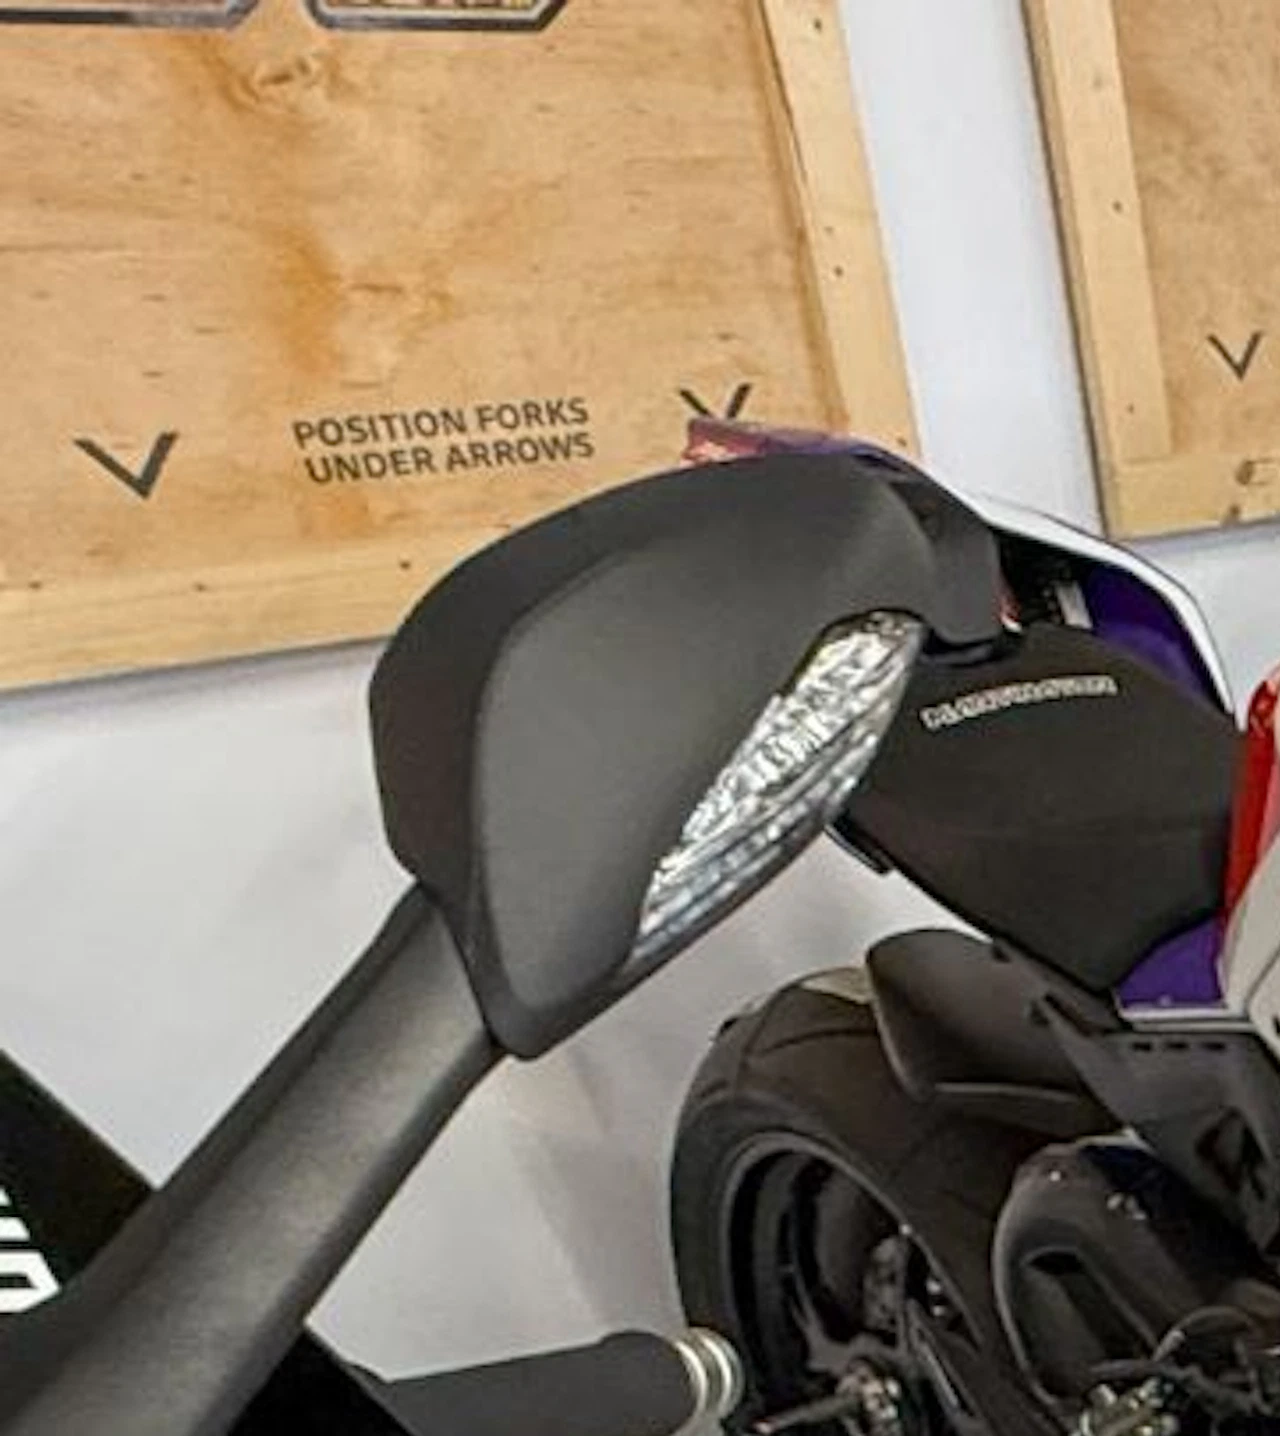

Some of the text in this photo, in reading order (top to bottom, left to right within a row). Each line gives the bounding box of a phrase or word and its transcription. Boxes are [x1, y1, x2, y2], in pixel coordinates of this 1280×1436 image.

[292, 397, 590, 449] POSITION FORKS
[304, 431, 596, 484] UNDER ARROWS
